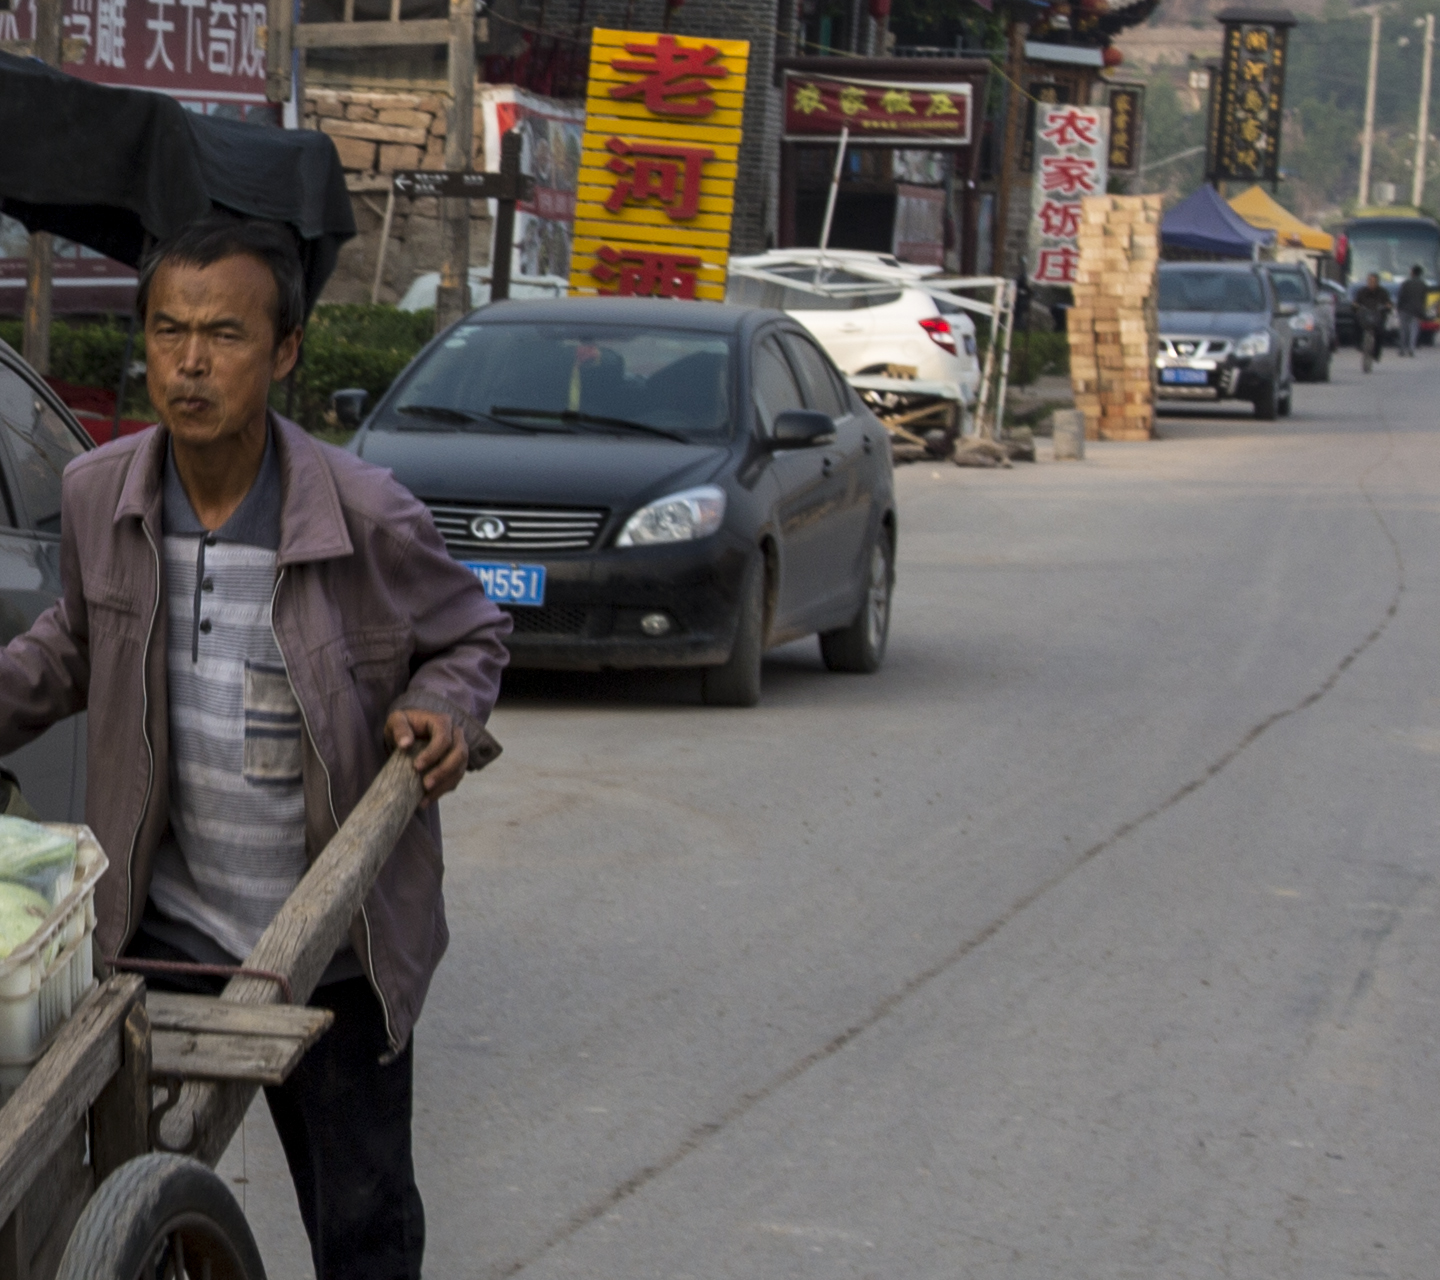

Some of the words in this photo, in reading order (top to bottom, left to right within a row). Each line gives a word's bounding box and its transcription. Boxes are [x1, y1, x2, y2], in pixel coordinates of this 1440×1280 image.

[589, 33, 730, 301] 老河酒
[1034, 109, 1098, 282] 农家饭庄
[472, 566, 539, 600] M551
